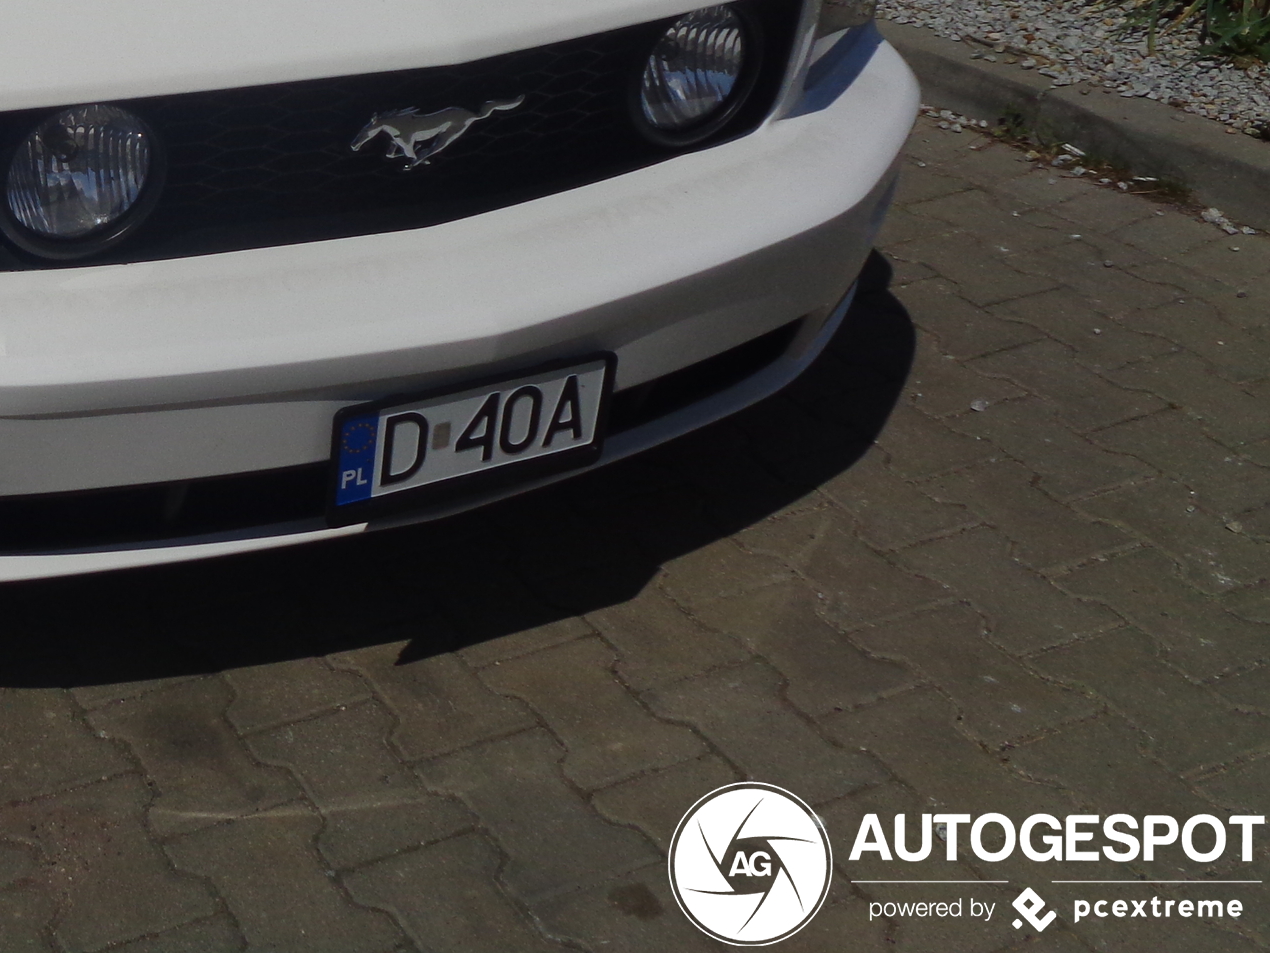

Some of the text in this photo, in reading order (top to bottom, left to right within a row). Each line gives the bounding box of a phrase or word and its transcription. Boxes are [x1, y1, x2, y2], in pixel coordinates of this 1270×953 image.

[380, 373, 583, 486] D 40A
[340, 467, 368, 490] PL
